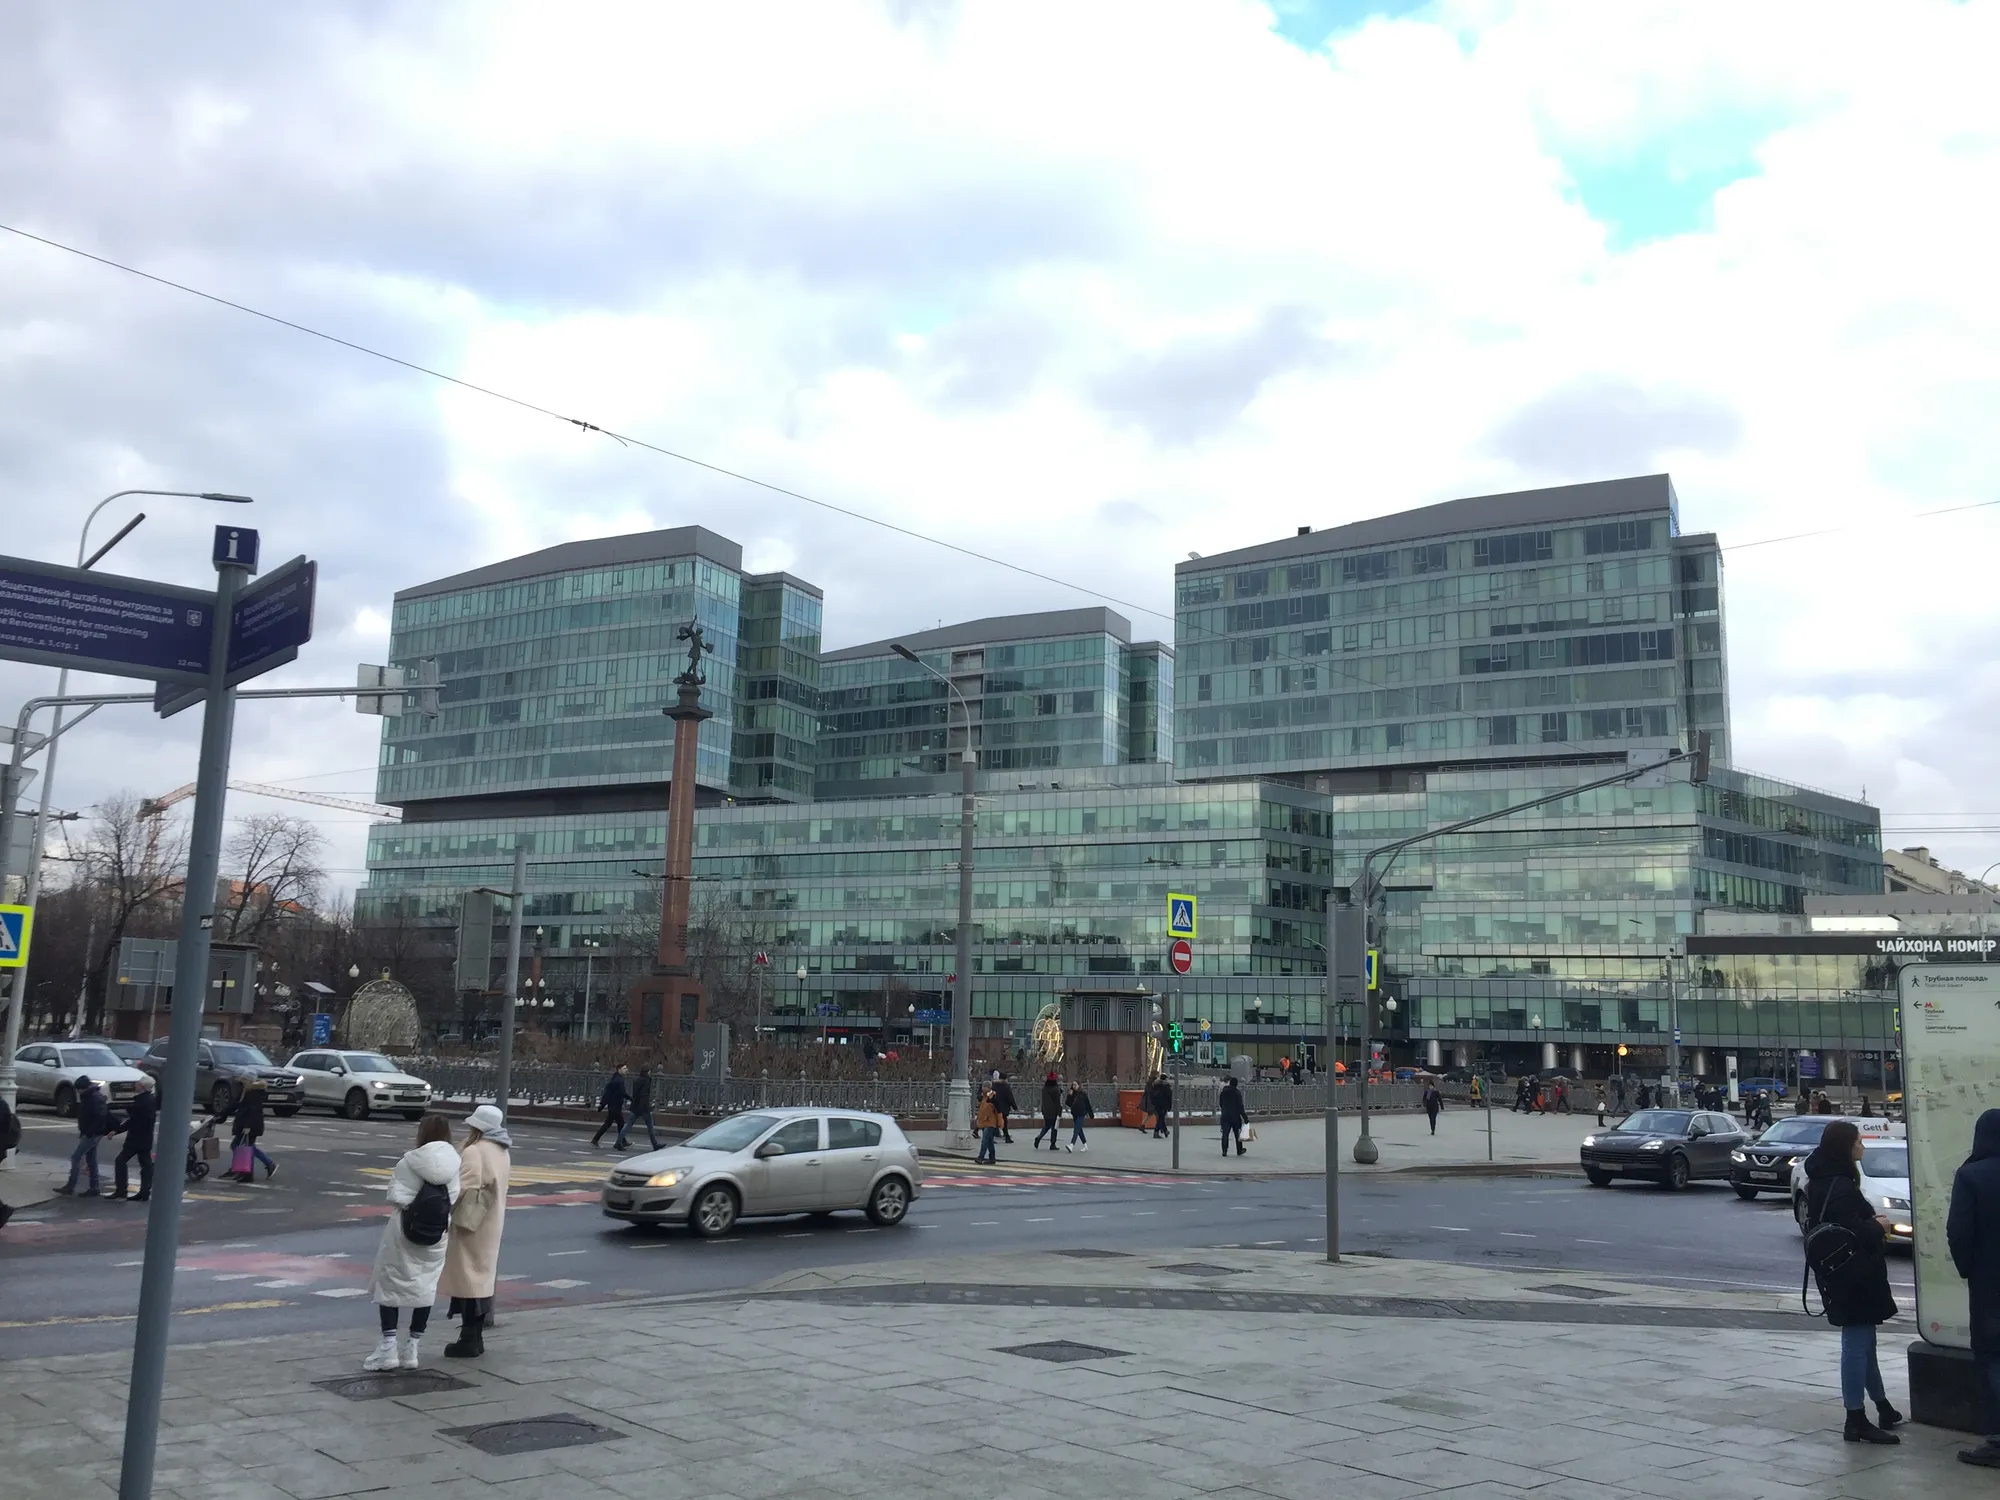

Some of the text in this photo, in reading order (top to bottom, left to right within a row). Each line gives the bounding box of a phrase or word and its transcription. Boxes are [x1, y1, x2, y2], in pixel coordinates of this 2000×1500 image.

[61, 599, 120, 616] Программы
[121, 610, 175, 624] реновации
[72, 593, 98, 603] штаб
[99, 597, 112, 605] по
[113, 600, 161, 613] контролю
[162, 607, 173, 615] за
[9, 617, 65, 633] Renovation
[65, 627, 108, 639] program
[23, 612, 77, 626] committee
[79, 619, 94, 629] for
[94, 623, 149, 639] monitoring
[1876, 937, 1997, 953] ЧАЙХОНА НОМЕР
[1924, 975, 1954, 983] Трубная
[1851, 1052, 1879, 1060] КОФЕ
